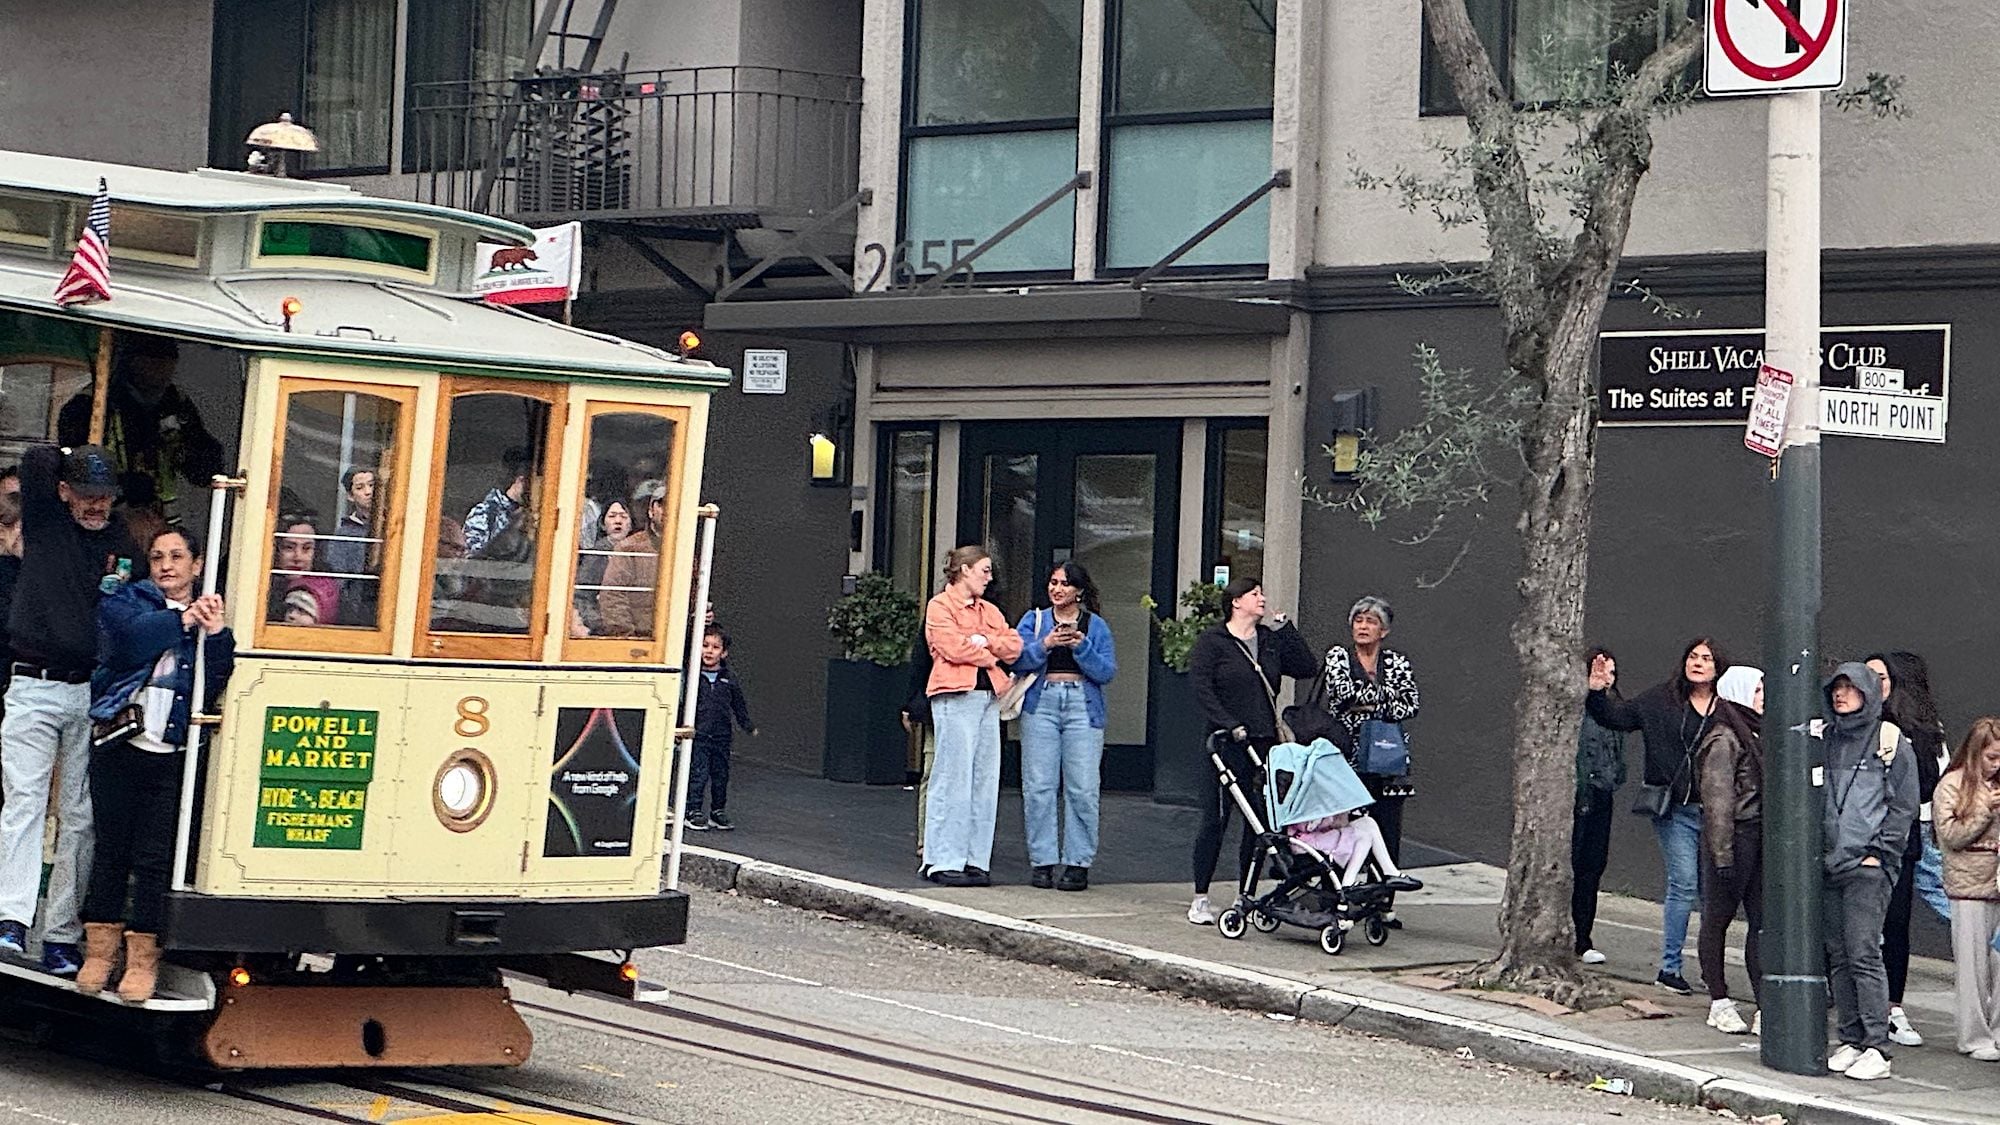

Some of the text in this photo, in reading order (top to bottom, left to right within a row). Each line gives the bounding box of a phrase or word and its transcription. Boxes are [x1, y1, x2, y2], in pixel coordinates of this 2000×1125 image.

[863, 239, 976, 293] 2655
[1649, 346, 1711, 374] SHELL
[1828, 342, 1887, 370] CLUB
[1864, 372, 1886, 388] 800
[1608, 387, 1644, 409] The
[1650, 387, 1709, 409] Suites
[1713, 388, 1735, 408] at
[1755, 403, 1781, 421] AT ALL
[1827, 399, 1935, 431] NORTH POINT
[1755, 416, 1775, 432] TIMES
[271, 715, 373, 736] POWELL
[454, 695, 490, 738] 8
[296, 735, 348, 749] AND
[266, 749, 373, 769] MARKET
[261, 787, 299, 809] HYDE
[318, 788, 366, 811] BEACH
[267, 811, 354, 829] FISHERMANS
[286, 828, 332, 843] WHARF
